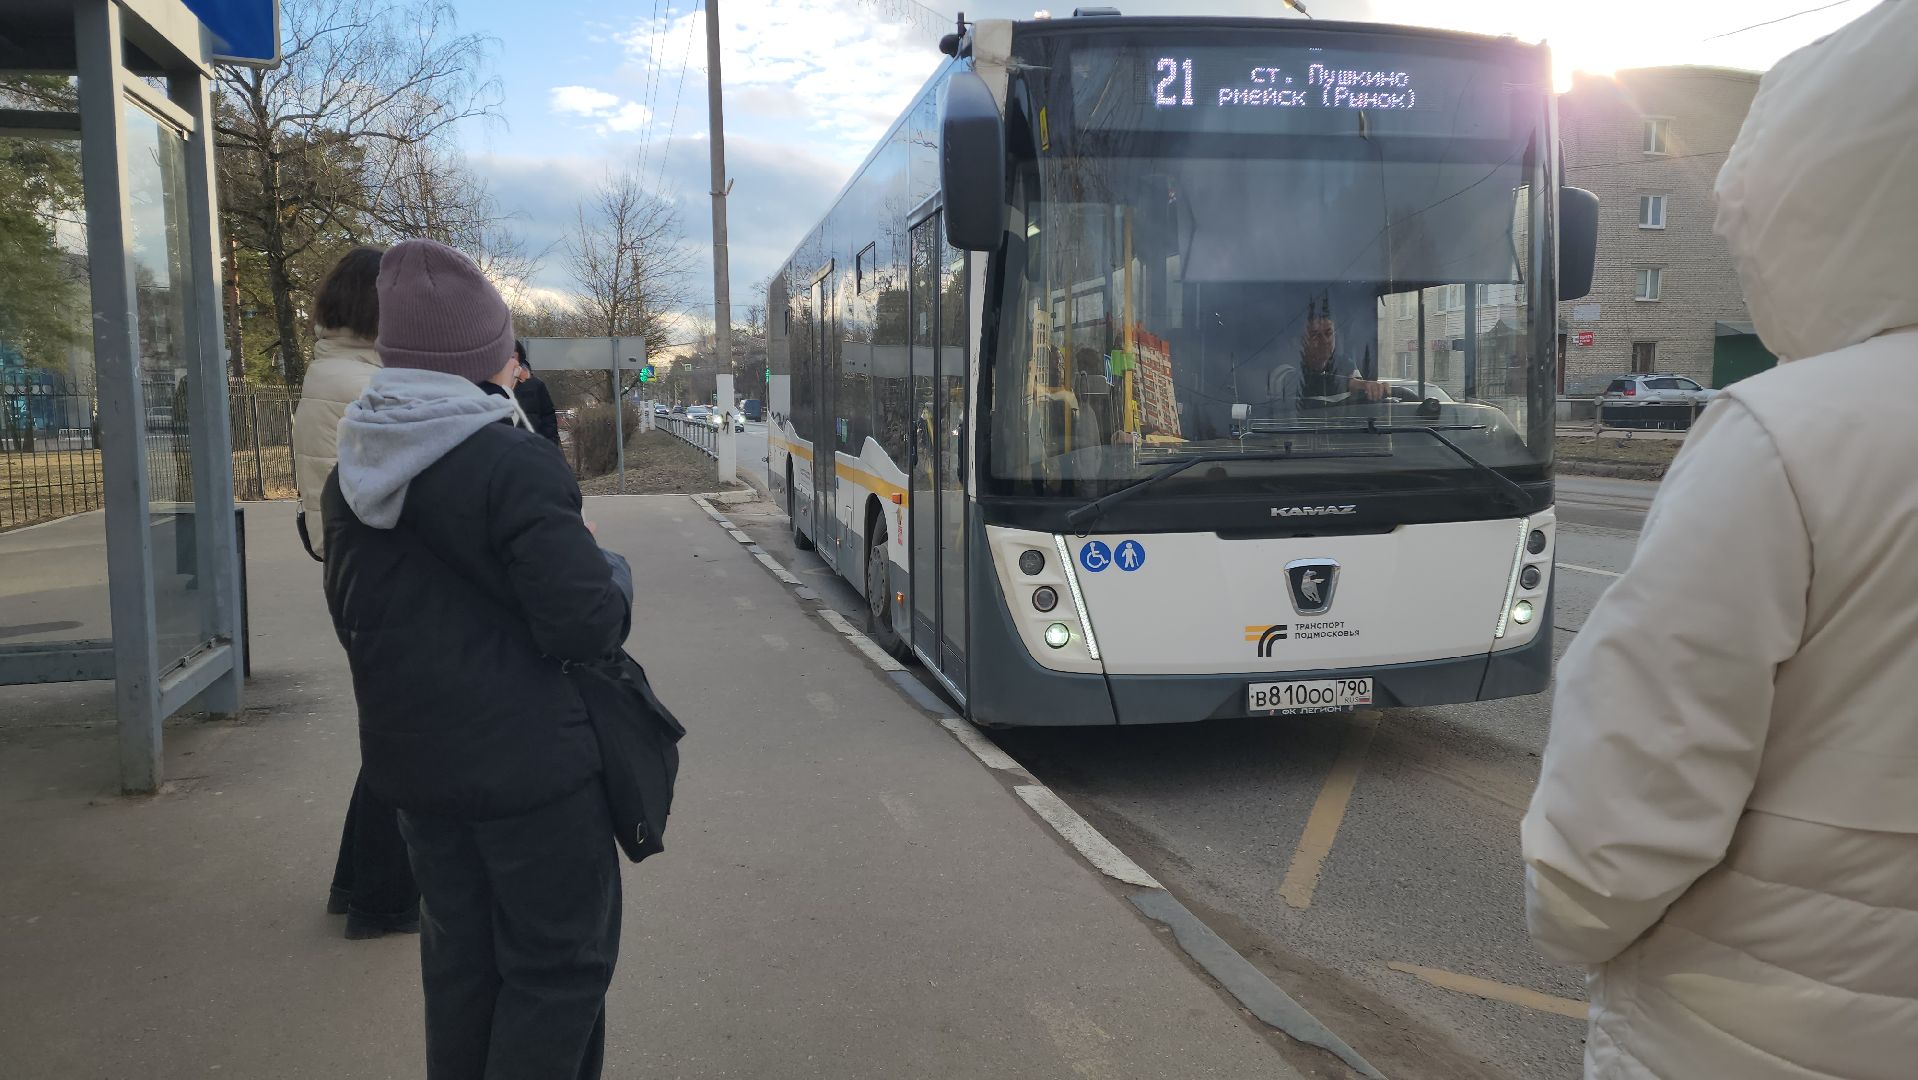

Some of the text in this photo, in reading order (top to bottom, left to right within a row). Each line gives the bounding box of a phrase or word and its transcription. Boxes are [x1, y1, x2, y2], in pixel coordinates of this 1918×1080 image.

[1156, 57, 1194, 106] 21
[1308, 63, 1410, 91] Пушкино
[1270, 504, 1357, 517] KAMAZ
[1294, 621, 1345, 631] ТРАНСПОРТ
[1294, 629, 1360, 640] ПОДМОСКОВЬЯ
[1337, 679, 1367, 697] 790
[1344, 696, 1359, 704] RUS
[1300, 705, 1342, 714] ЛЕГИОН
